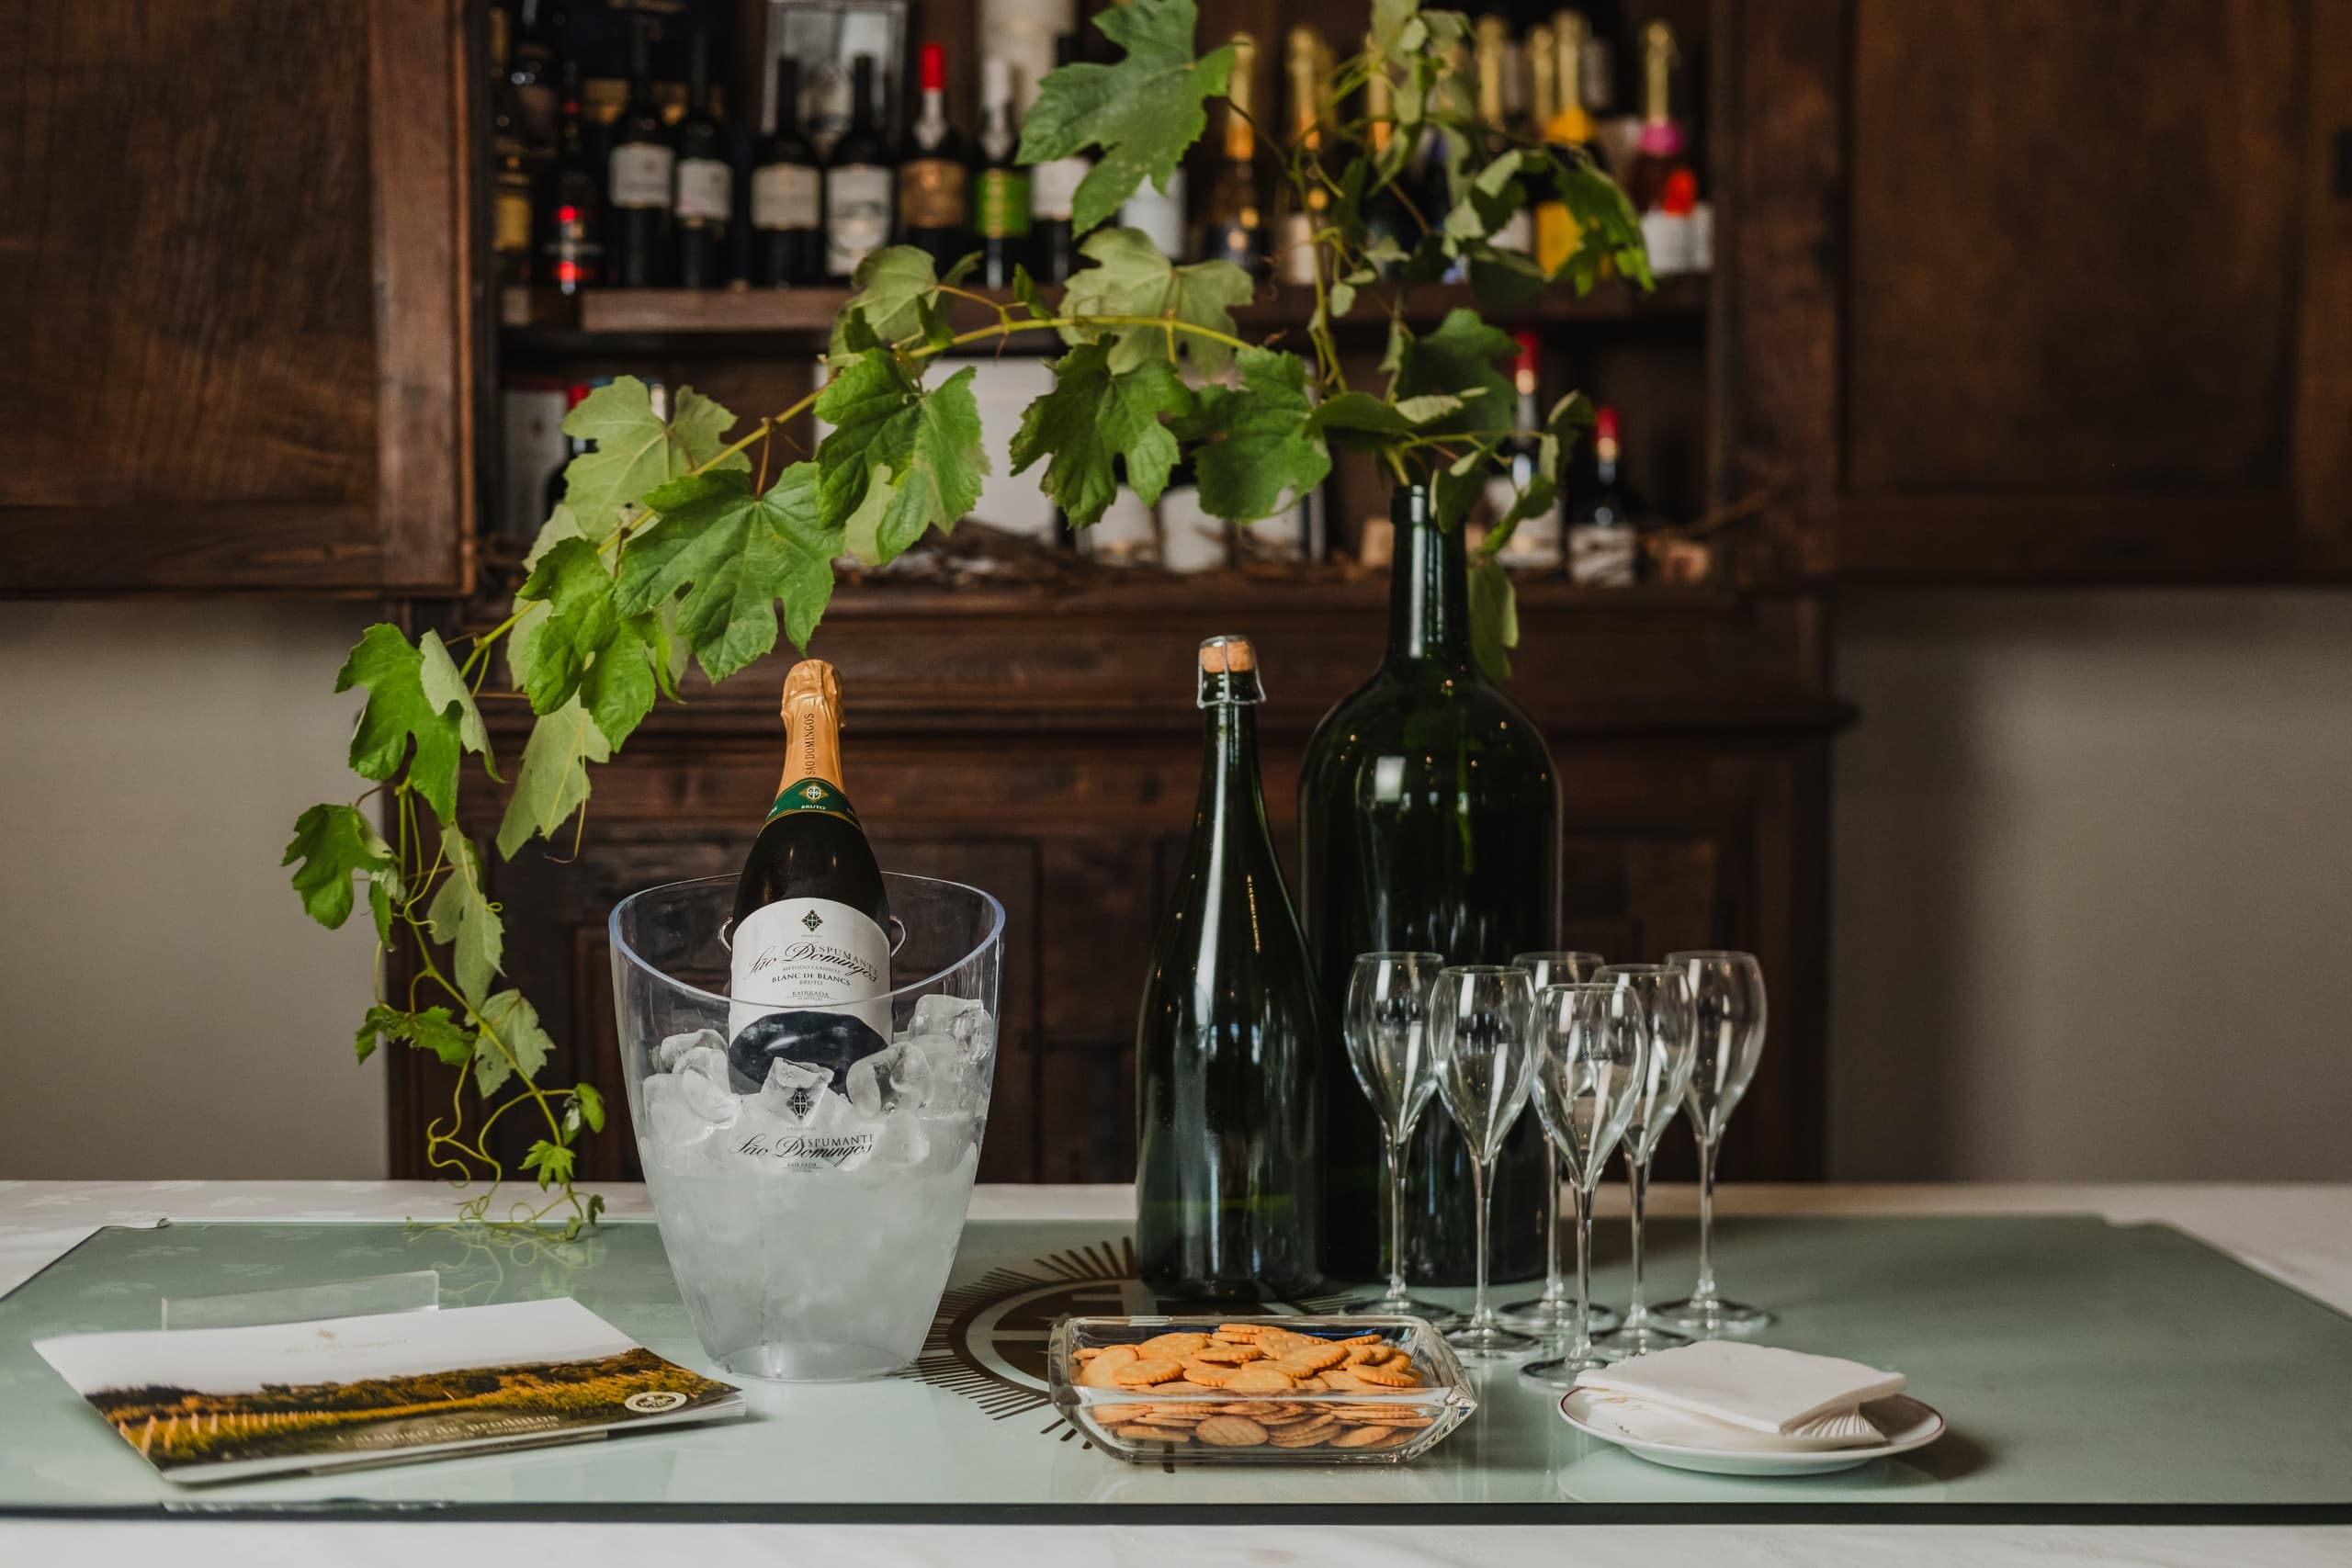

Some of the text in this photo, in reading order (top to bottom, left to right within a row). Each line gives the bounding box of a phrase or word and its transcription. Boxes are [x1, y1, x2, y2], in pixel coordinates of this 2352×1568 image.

[803, 713, 816, 760] DOMINGOS
[772, 973, 801, 983] BLANC
[817, 973, 851, 986] BLANCS
[782, 942, 877, 983] Domingos
[772, 1134, 874, 1168] Domingos
[806, 1133, 875, 1147] SPUMANTE
